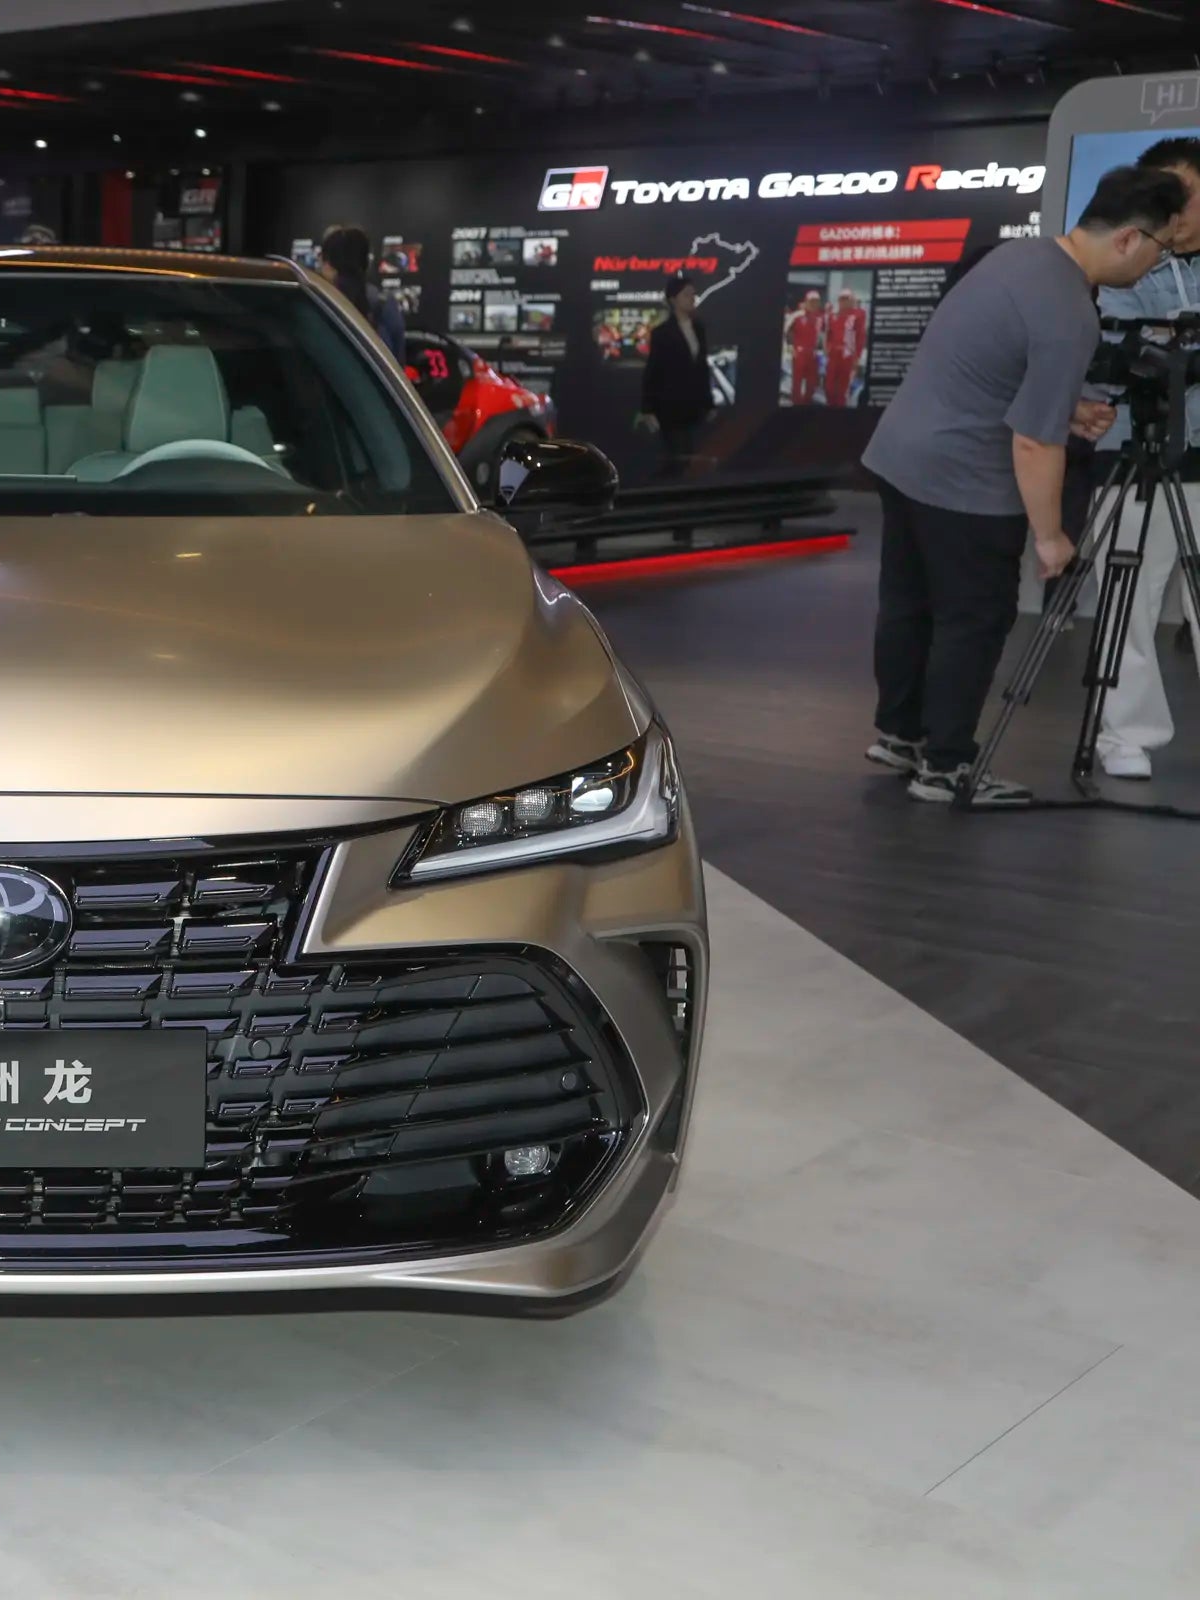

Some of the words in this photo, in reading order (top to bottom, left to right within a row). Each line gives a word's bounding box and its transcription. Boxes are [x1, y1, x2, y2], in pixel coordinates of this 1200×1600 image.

[1157, 84, 1184, 106] Hi
[611, 178, 750, 205] TOYOTA
[758, 170, 898, 198] GAZOO
[904, 162, 1046, 194] Racing
[4, 1117, 147, 1132] CONCEPT
